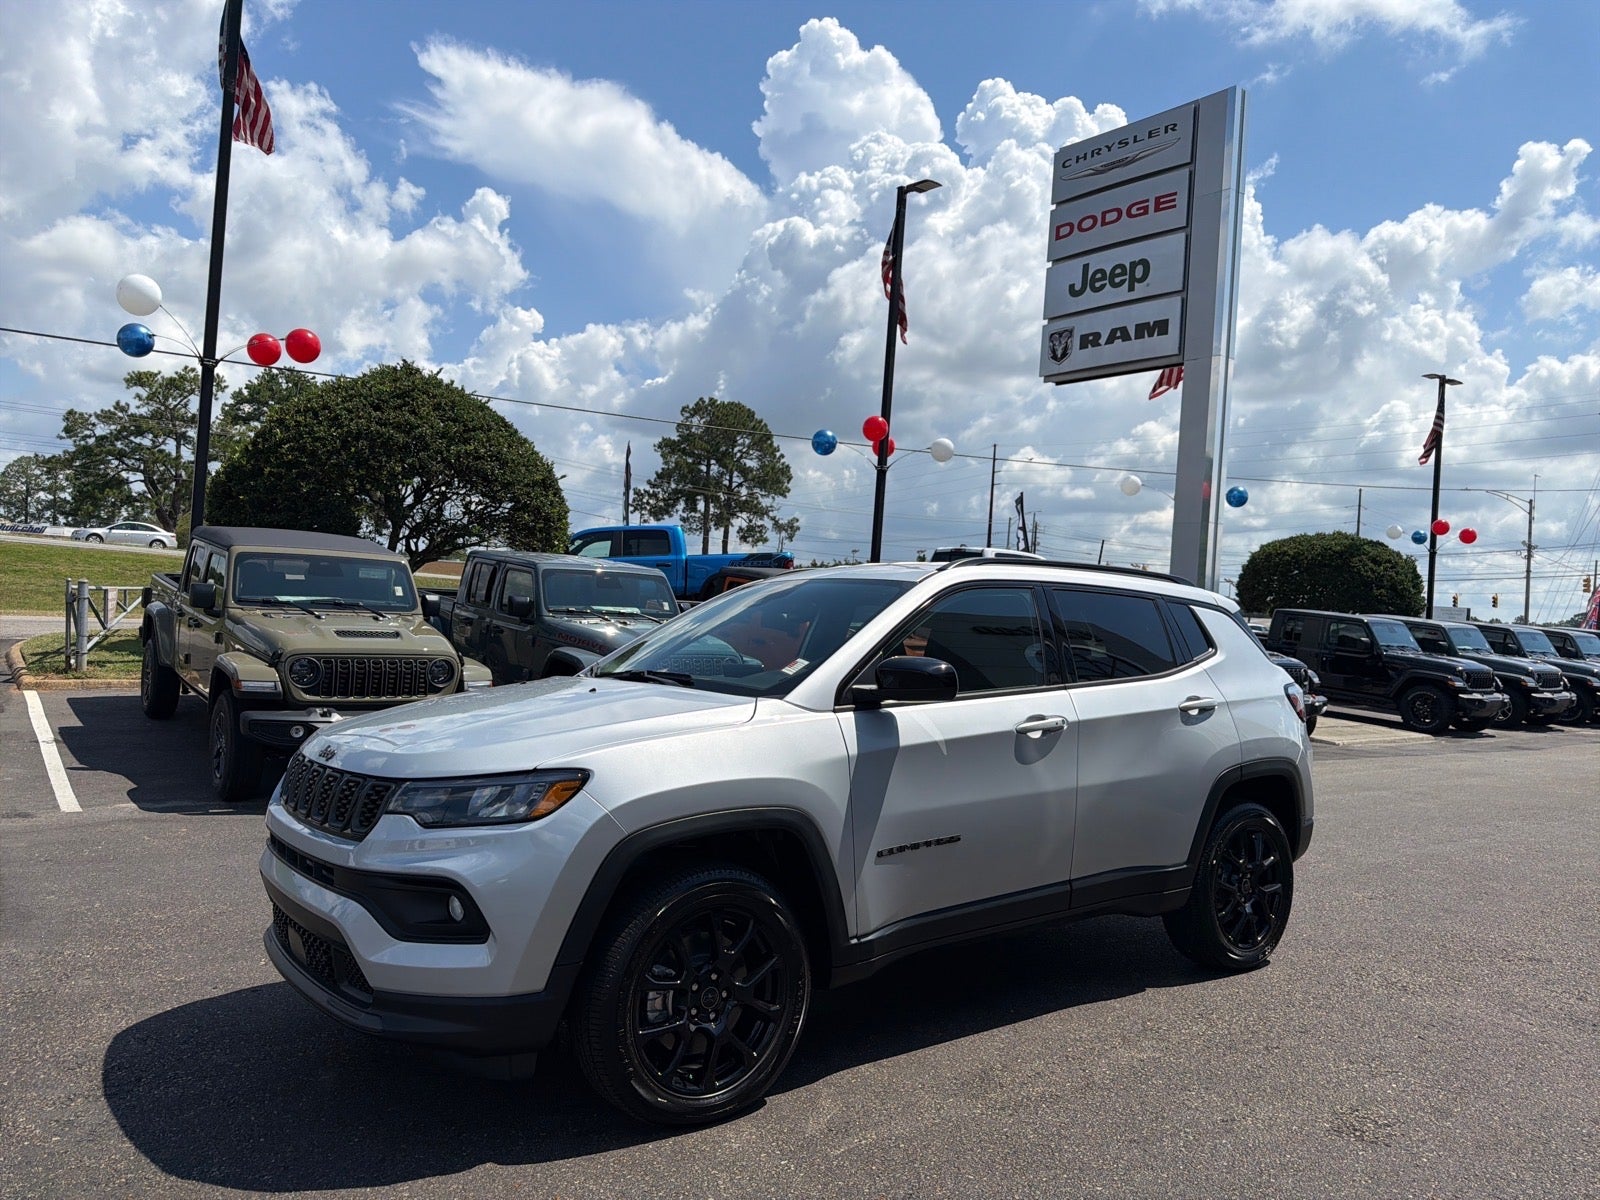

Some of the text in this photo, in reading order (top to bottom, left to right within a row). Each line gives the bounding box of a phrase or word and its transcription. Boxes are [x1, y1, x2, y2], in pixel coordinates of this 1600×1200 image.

[1061, 123, 1178, 169] CHRYSLER
[1055, 192, 1177, 241] DODGE
[1069, 258, 1150, 298] Jeep
[1079, 319, 1169, 350] RAM
